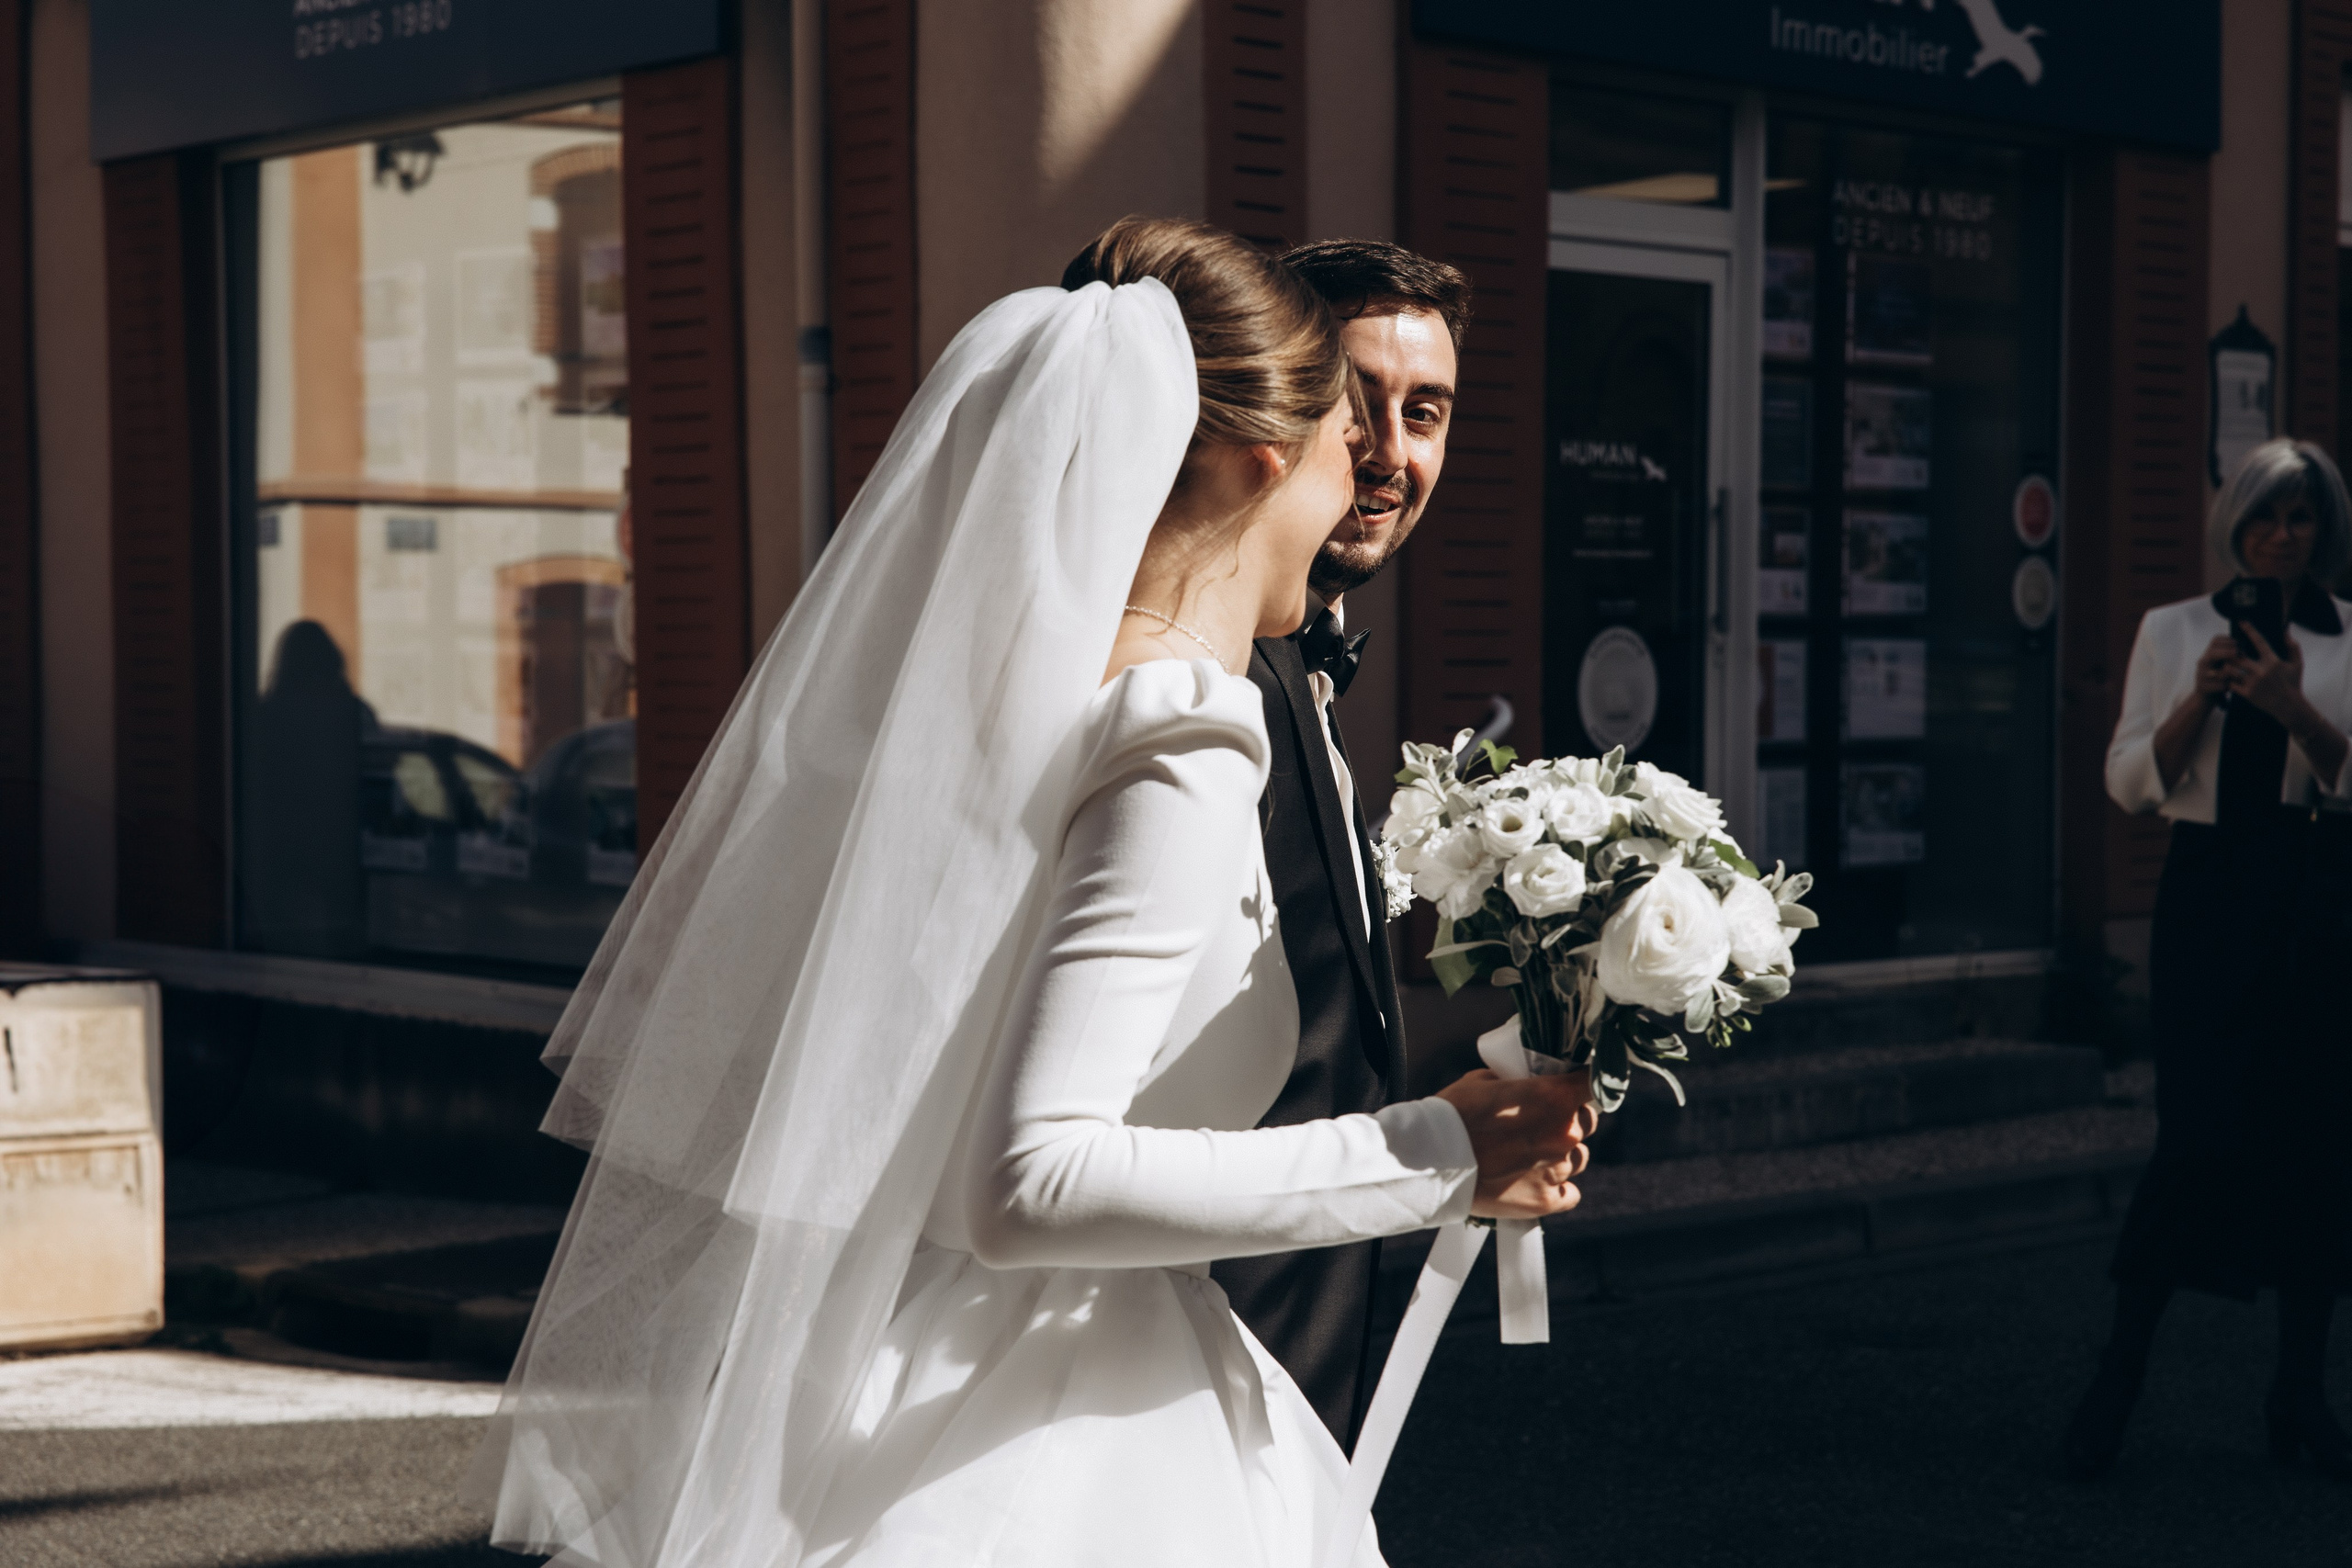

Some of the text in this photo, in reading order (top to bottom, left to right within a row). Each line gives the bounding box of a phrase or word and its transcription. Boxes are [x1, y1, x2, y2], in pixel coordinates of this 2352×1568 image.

[294, 0, 453, 60] DEPUIS 1980
[1770, 6, 1948, 74] Immobilier
[1832, 180, 1912, 213] ANCIEN
[1937, 192, 1995, 222] NEUF
[1834, 214, 1993, 262] DEPUIS 1980
[1560, 440, 1637, 466] HUMAN
